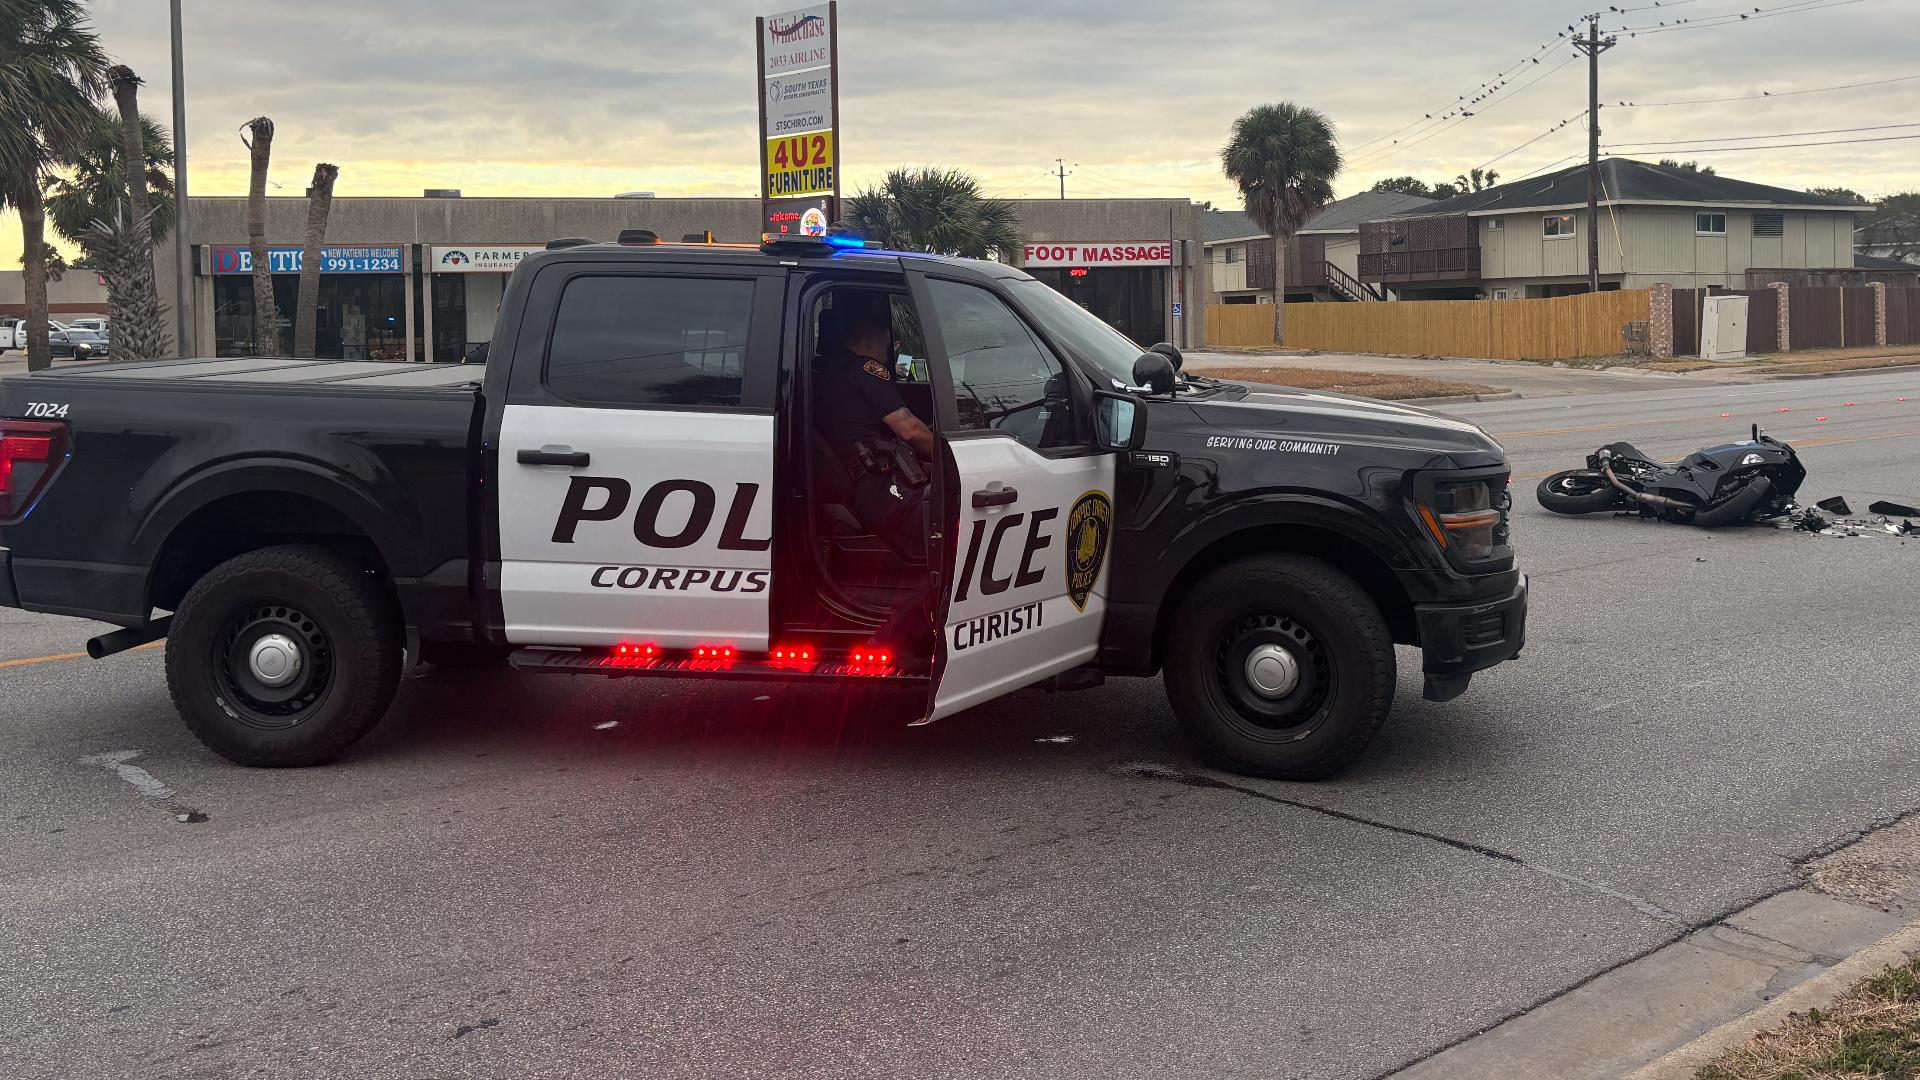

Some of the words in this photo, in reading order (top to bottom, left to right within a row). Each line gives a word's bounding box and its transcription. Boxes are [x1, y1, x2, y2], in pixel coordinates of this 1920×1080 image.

[768, 13, 825, 46] Windchase
[770, 55, 787, 68] 2033
[788, 48, 825, 65] AIRLINE
[784, 82, 806, 94] SOUTH
[808, 78, 827, 90] TEXAS
[776, 115, 823, 130] STSCHIRO.COM
[775, 135, 826, 169] 4U2
[769, 167, 832, 194] FURNITURE
[781, 224, 788, 233] to
[328, 248, 342, 258] NEW
[343, 248, 369, 258] PATIENTS
[370, 248, 399, 258] WELCOME
[475, 251, 530, 260] FARMER
[1024, 246, 1077, 262] FOOT
[1083, 245, 1171, 262] MASSAGE
[328, 258, 399, 271] 991-1234
[24, 402, 70, 418] 7024
[1207, 436, 1253, 449] SERVING
[1254, 439, 1277, 451] OUR
[1279, 441, 1340, 456] COMMUNITY
[551, 475, 773, 551] POL
[954, 507, 1059, 602] ICE
[590, 566, 769, 593] CORPUS
[954, 602, 1043, 651] CHRISTI
